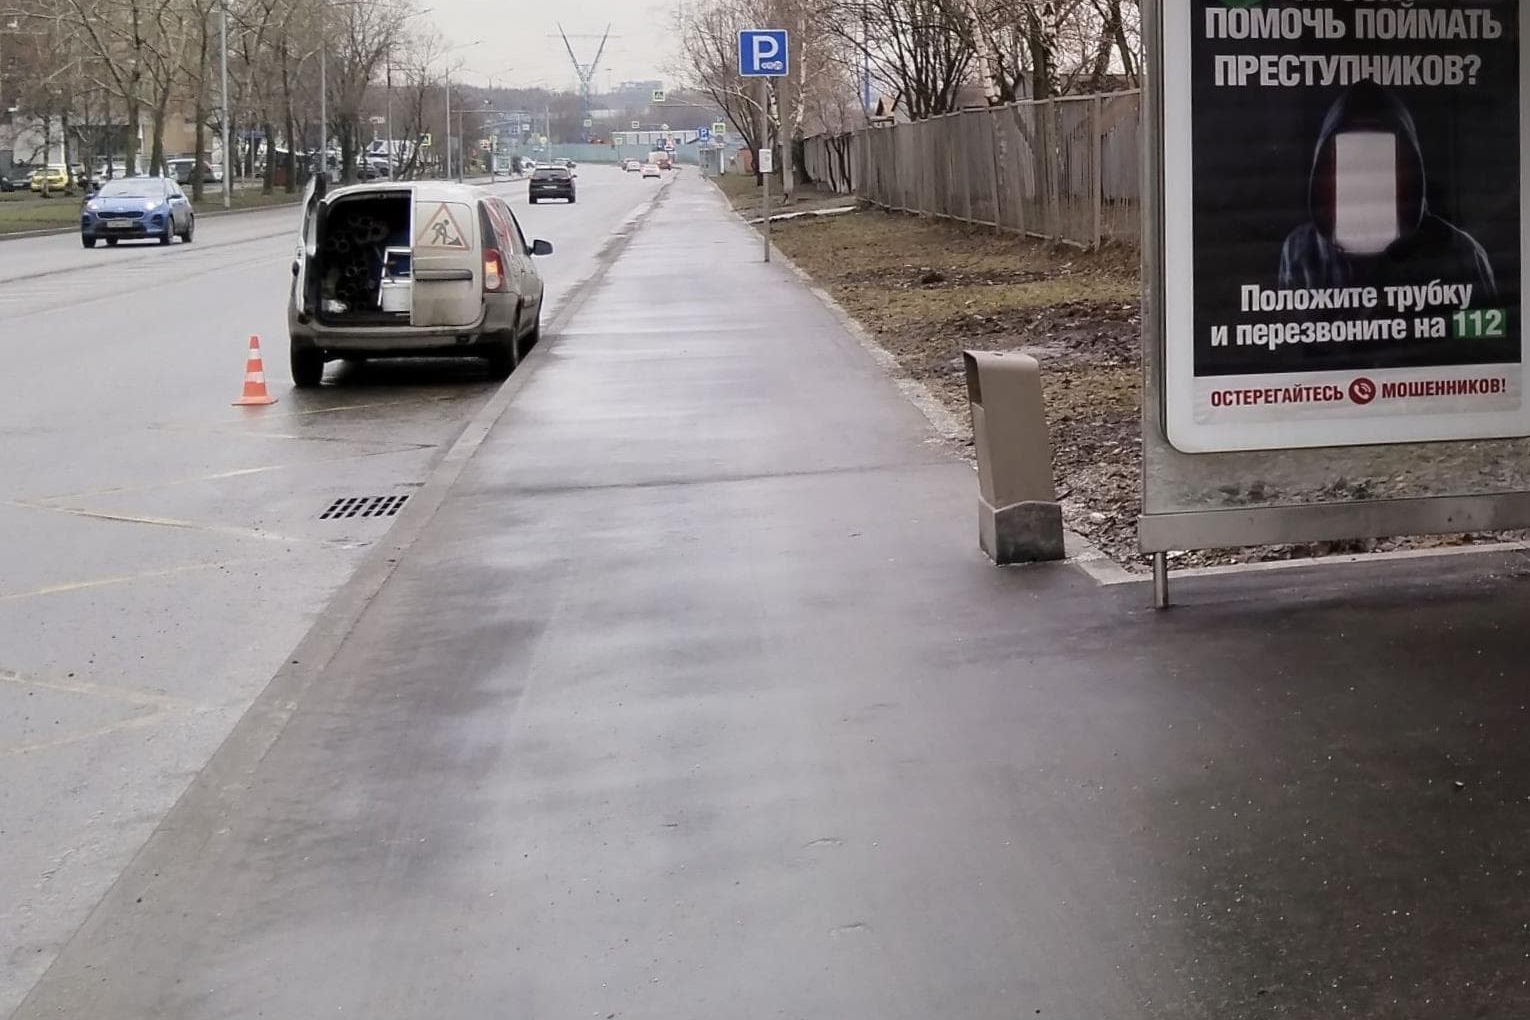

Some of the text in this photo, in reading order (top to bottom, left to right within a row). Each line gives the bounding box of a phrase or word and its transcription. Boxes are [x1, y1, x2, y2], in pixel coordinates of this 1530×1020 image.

[1205, 1, 1503, 39] ПОМОЧЬ ПОЙМАТЬ
[753, 35, 778, 70] P
[1214, 54, 1482, 86] ПРЕСТУПНИКОВ?
[1240, 280, 1473, 312] Положите трубку
[1210, 309, 1502, 350] и перезвоните на 112
[1210, 378, 1506, 407] ОСТЕРЕГАЙТЕСЬ МОШЕННИКОВ!
